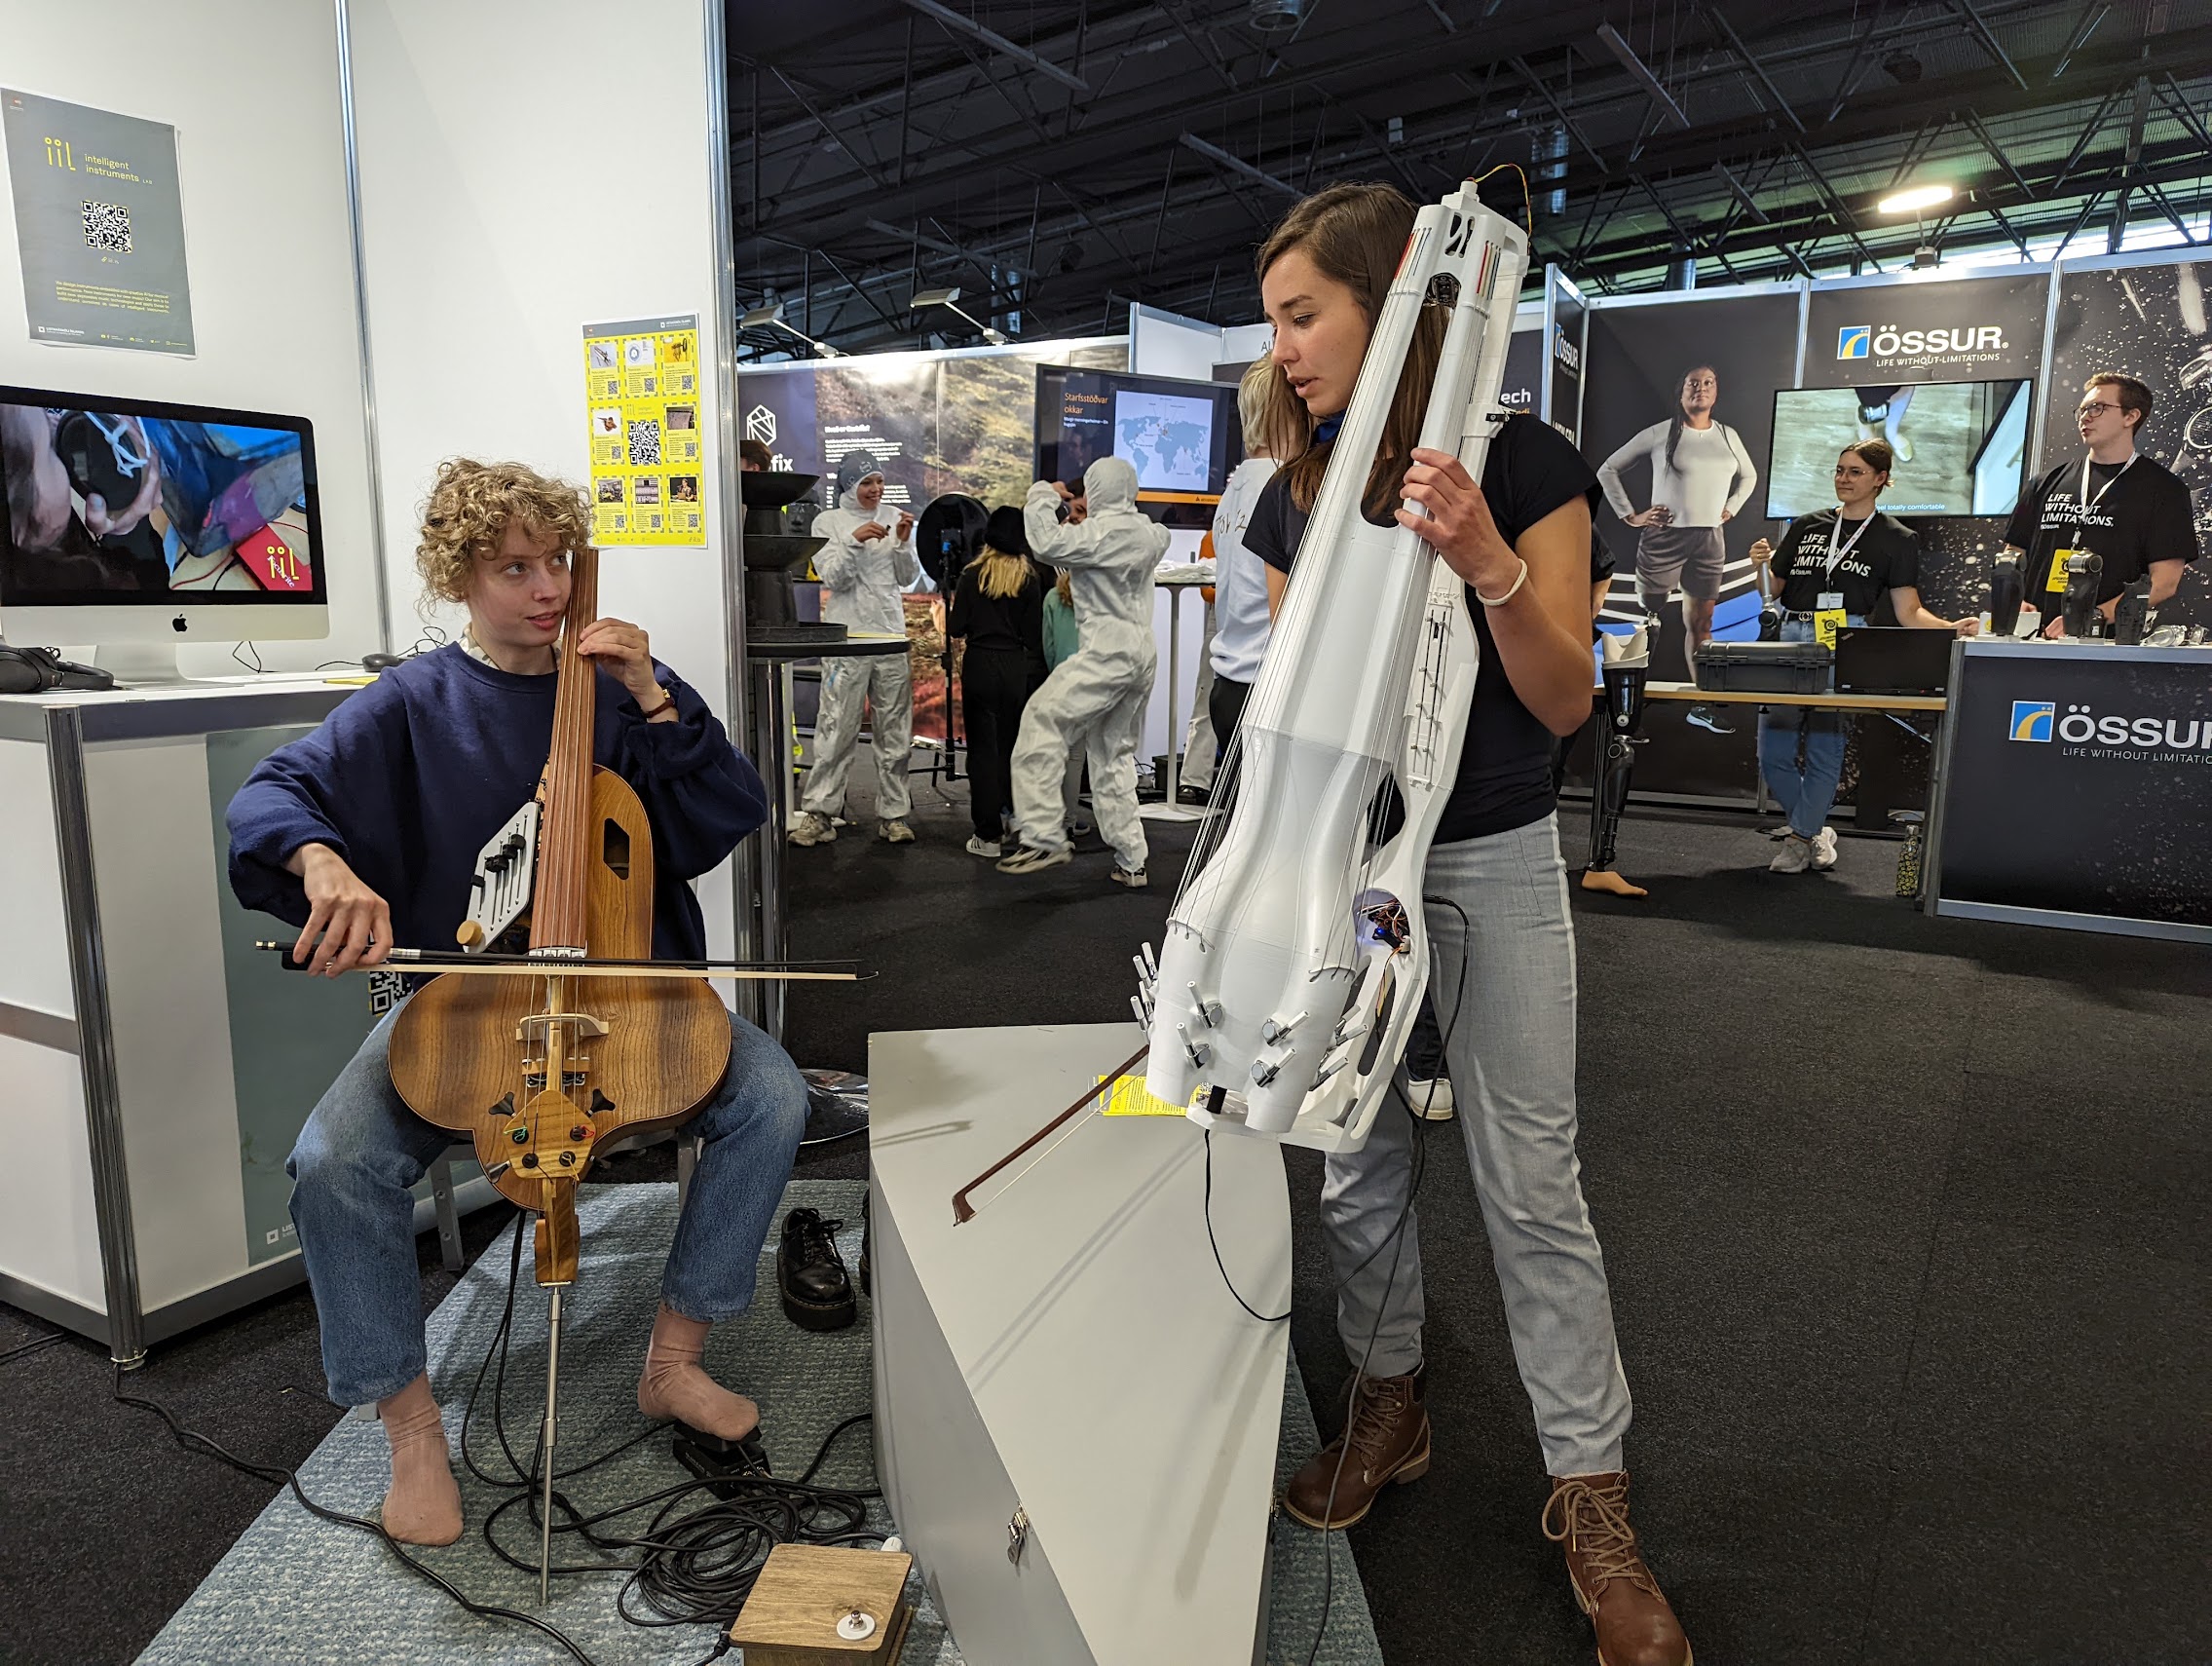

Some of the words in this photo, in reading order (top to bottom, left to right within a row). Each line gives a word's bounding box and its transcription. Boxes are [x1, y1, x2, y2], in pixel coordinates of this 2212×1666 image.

[84, 154, 130, 170] intelligent
[86, 165, 140, 182] instruments
[1876, 358, 1894, 367] LIFE
[1500, 388, 1531, 404] ech
[1064, 405, 1084, 414] okkar
[768, 452, 794, 473] fix
[2047, 493, 2073, 503] LIFE
[1801, 533, 1828, 545] LIFE
[2062, 747, 2086, 757] LIFE
[2090, 748, 2150, 761] WITHOUT
